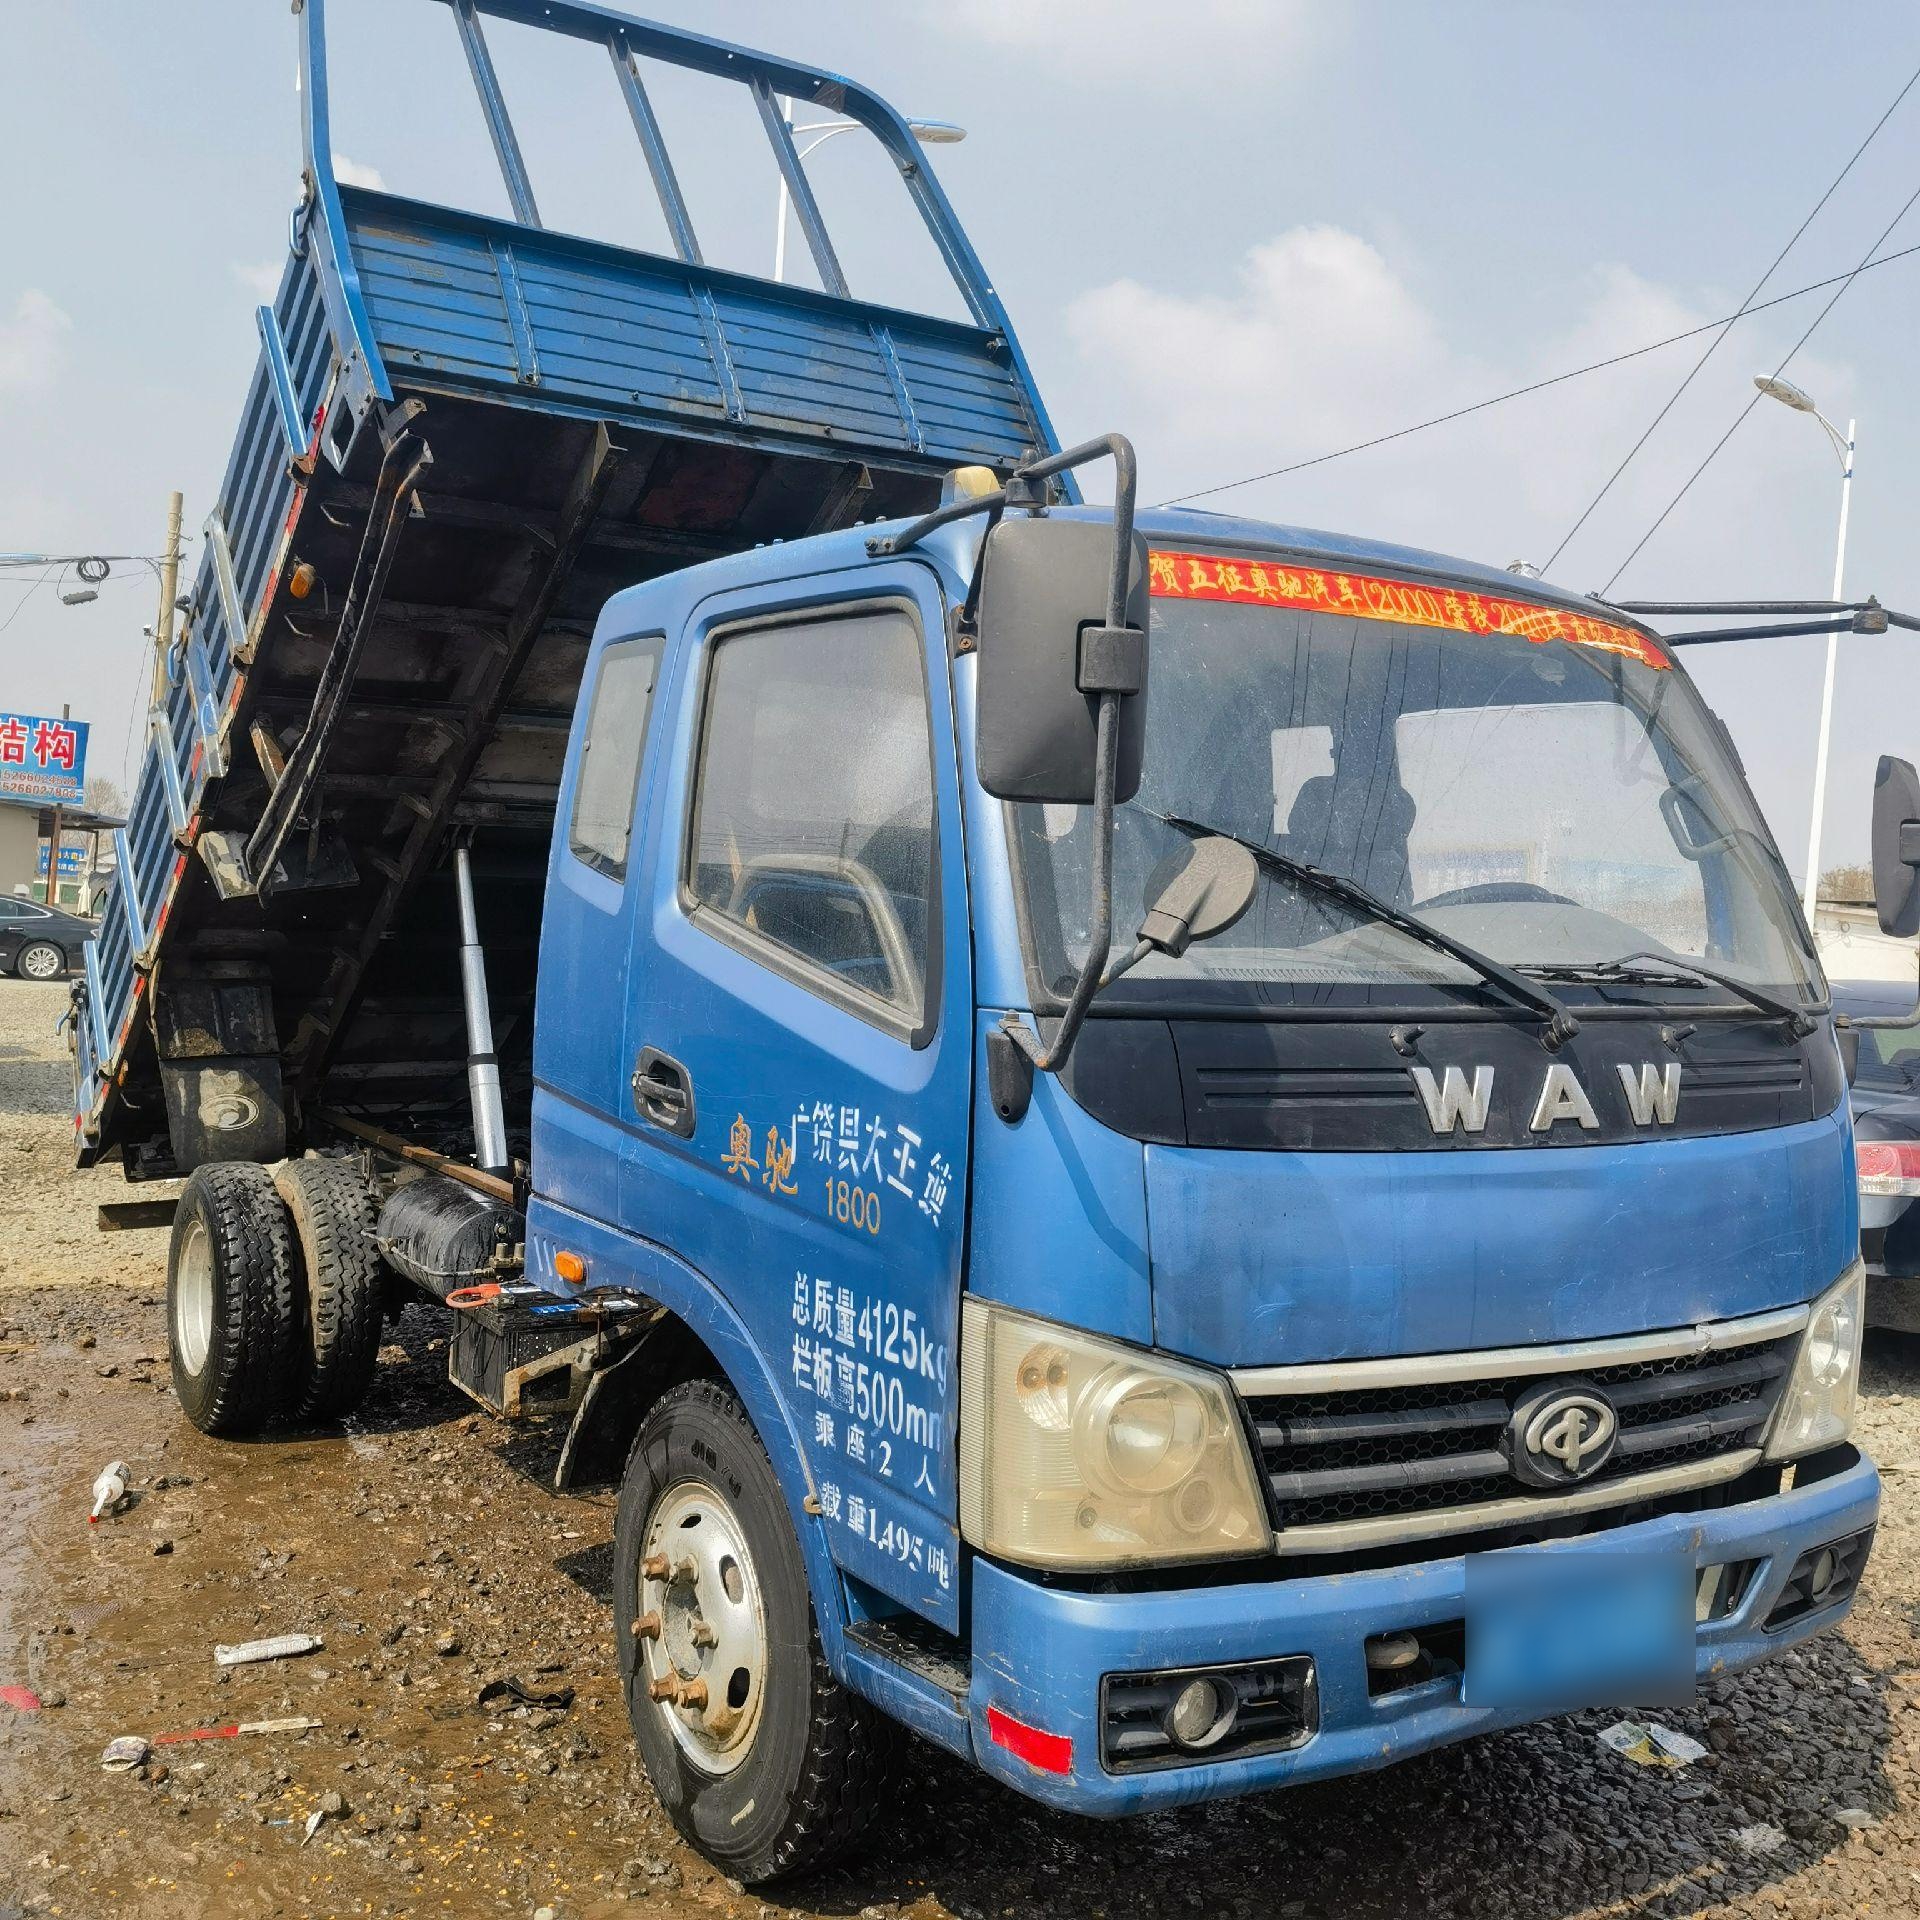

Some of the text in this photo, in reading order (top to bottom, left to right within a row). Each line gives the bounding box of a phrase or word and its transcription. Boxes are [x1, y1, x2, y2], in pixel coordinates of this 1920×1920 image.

[0, 717, 77, 770] 结构
[1411, 1063, 1682, 1134] WAW
[825, 1175, 882, 1235] 1800
[792, 1270, 948, 1398] 总质量4125kg
